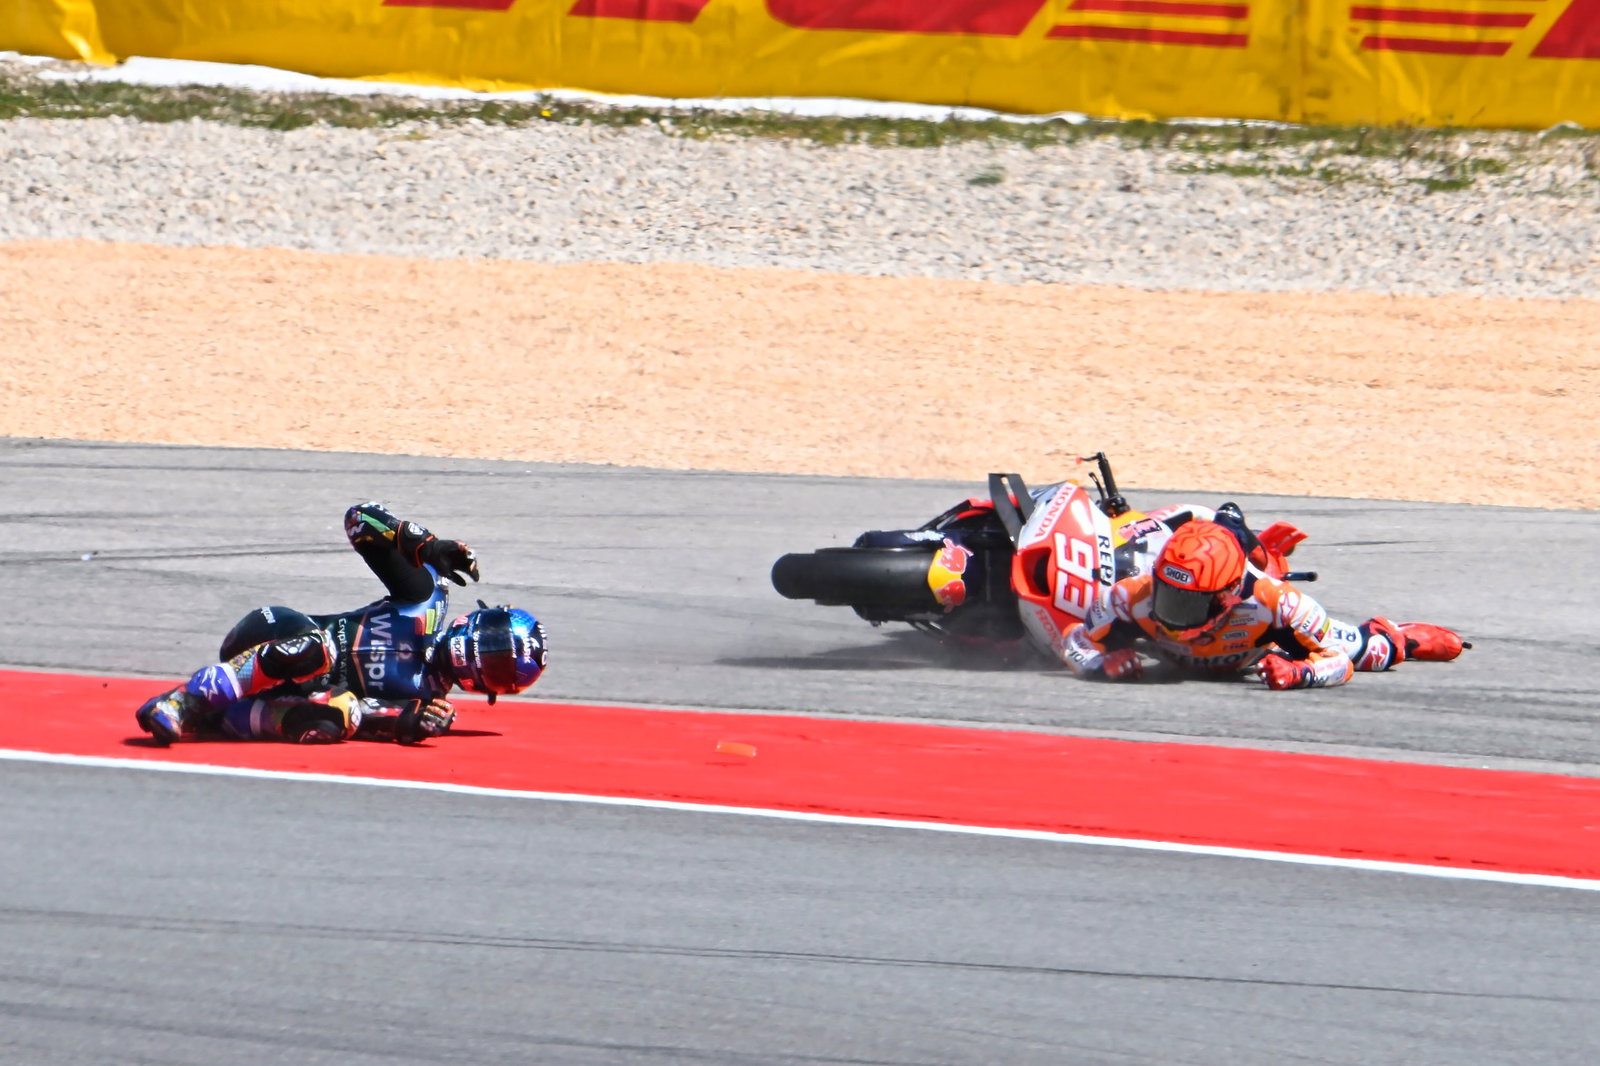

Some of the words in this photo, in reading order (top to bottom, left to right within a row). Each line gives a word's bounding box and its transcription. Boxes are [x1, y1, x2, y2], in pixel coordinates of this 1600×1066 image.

[1034, 485, 1076, 540] HONDA
[1053, 532, 1094, 621] 93
[364, 612, 393, 692] Wispr
